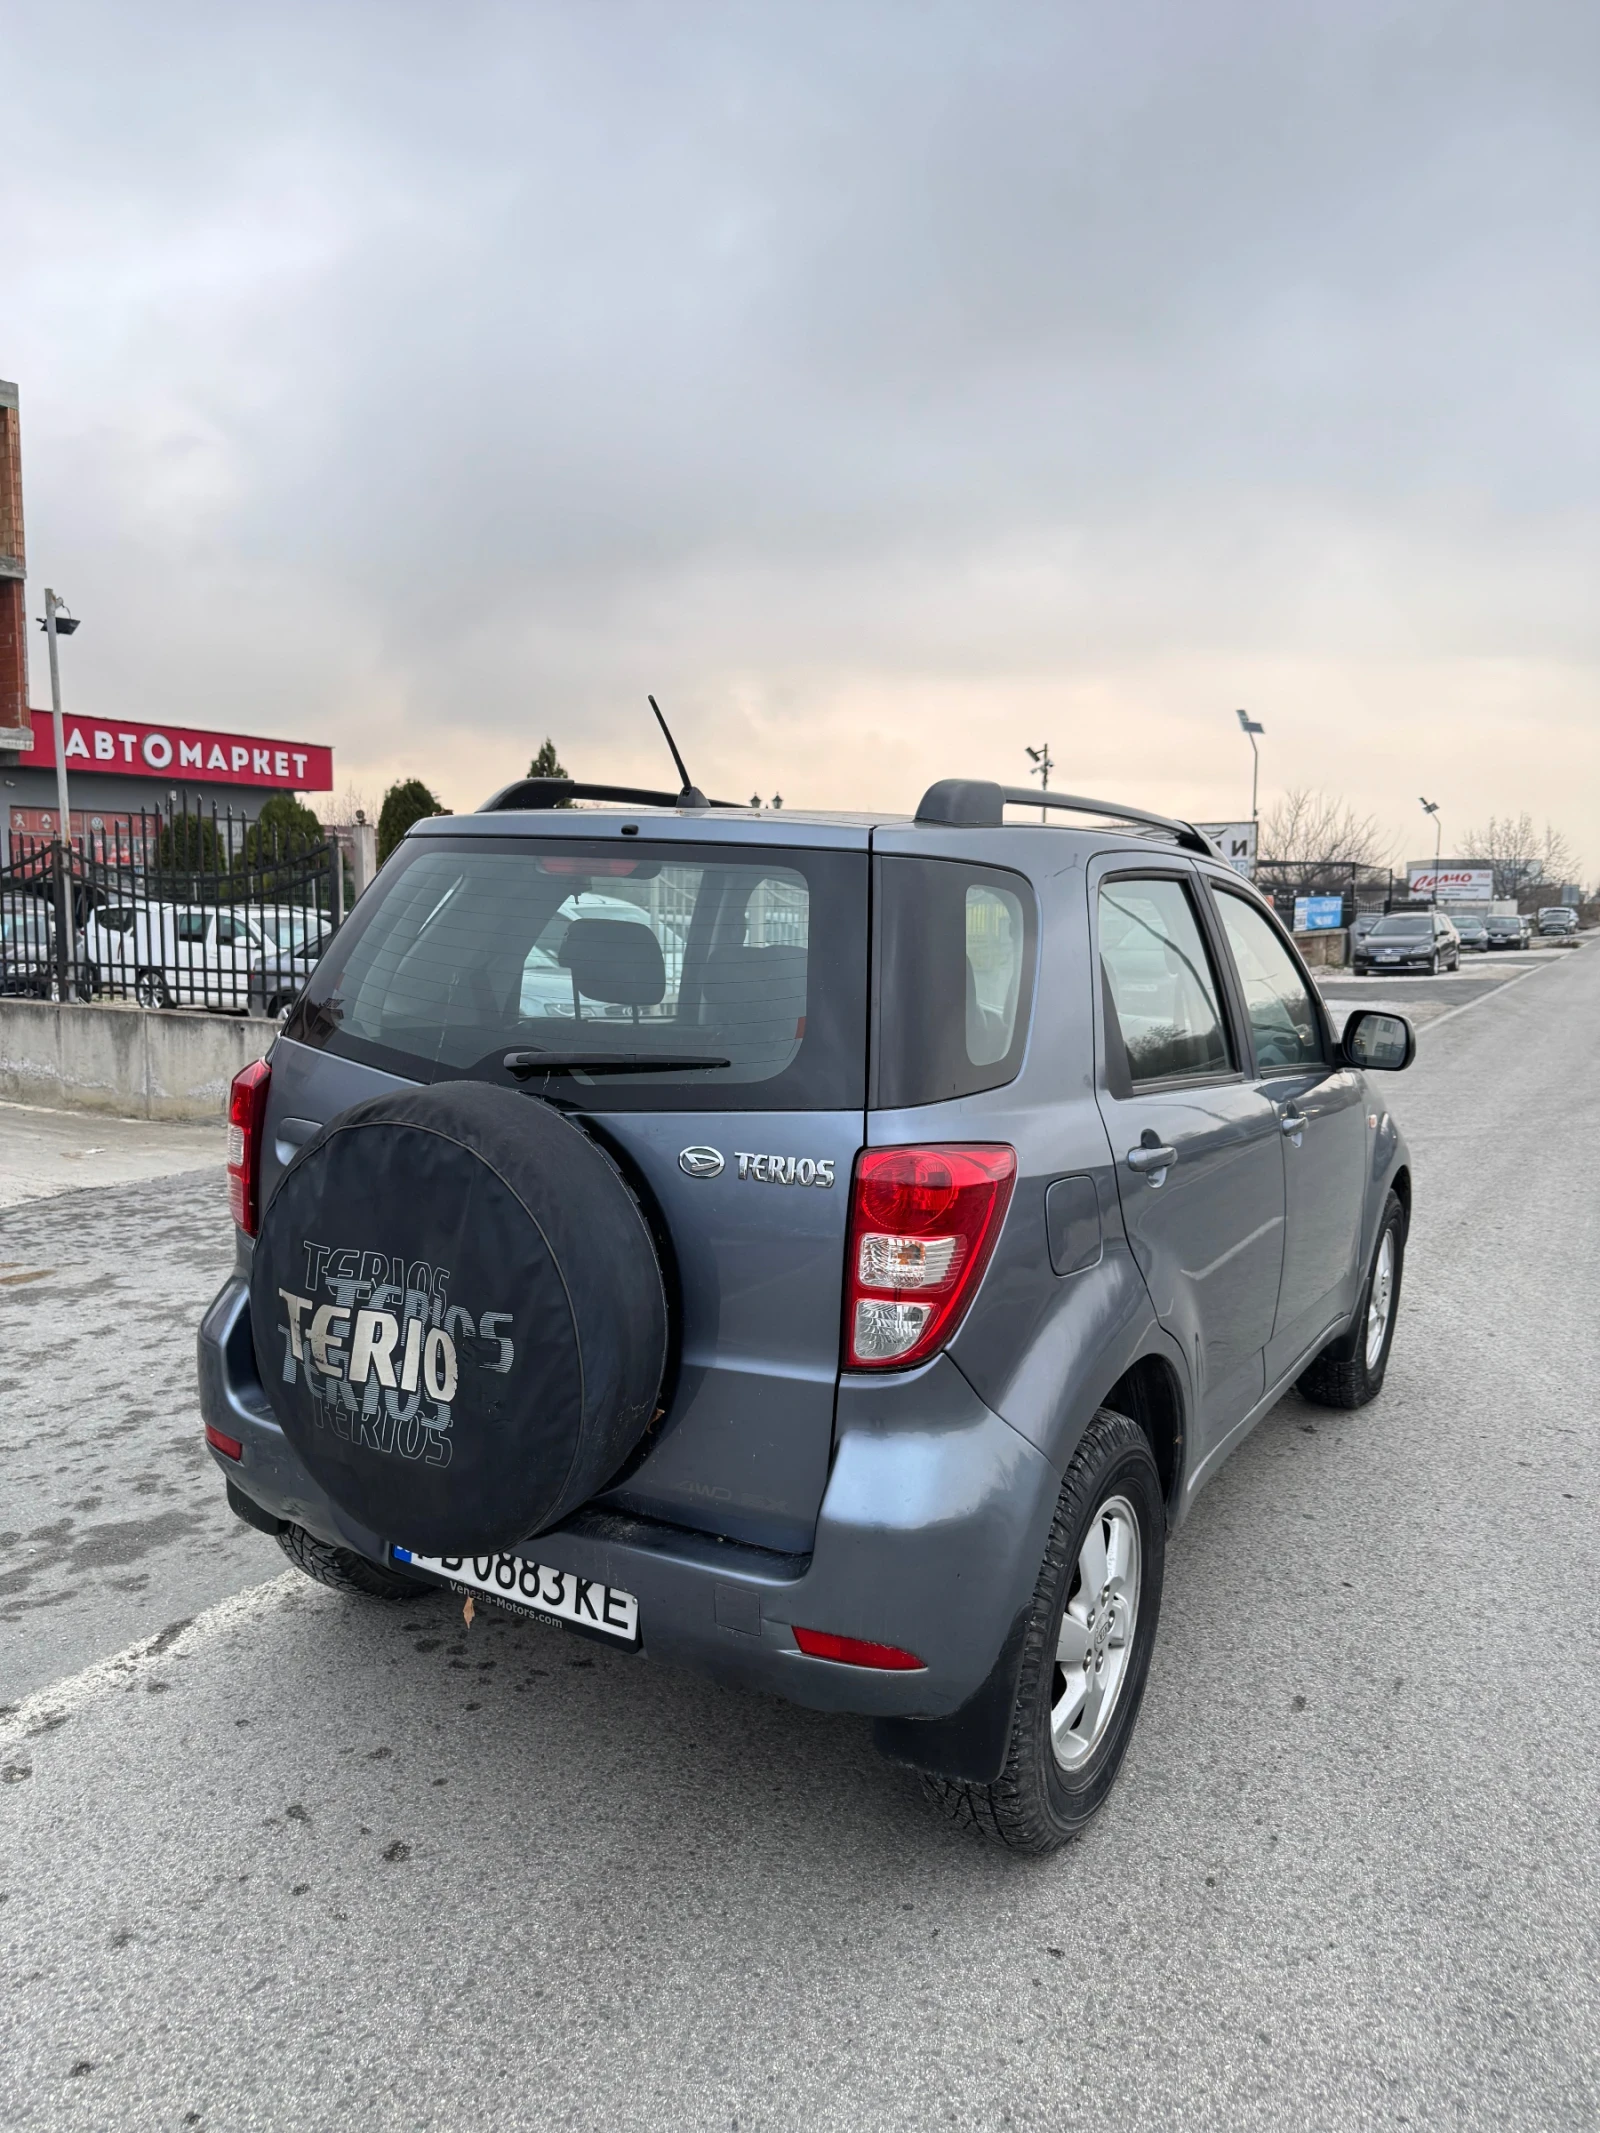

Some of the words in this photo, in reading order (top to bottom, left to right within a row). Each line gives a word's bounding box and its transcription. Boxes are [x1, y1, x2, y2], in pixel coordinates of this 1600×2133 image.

[65, 728, 308, 779] АВТОМАРКЕТ
[734, 1151, 835, 1188] TERIOS
[450, 1580, 563, 1629] Venezia-Motors.com
